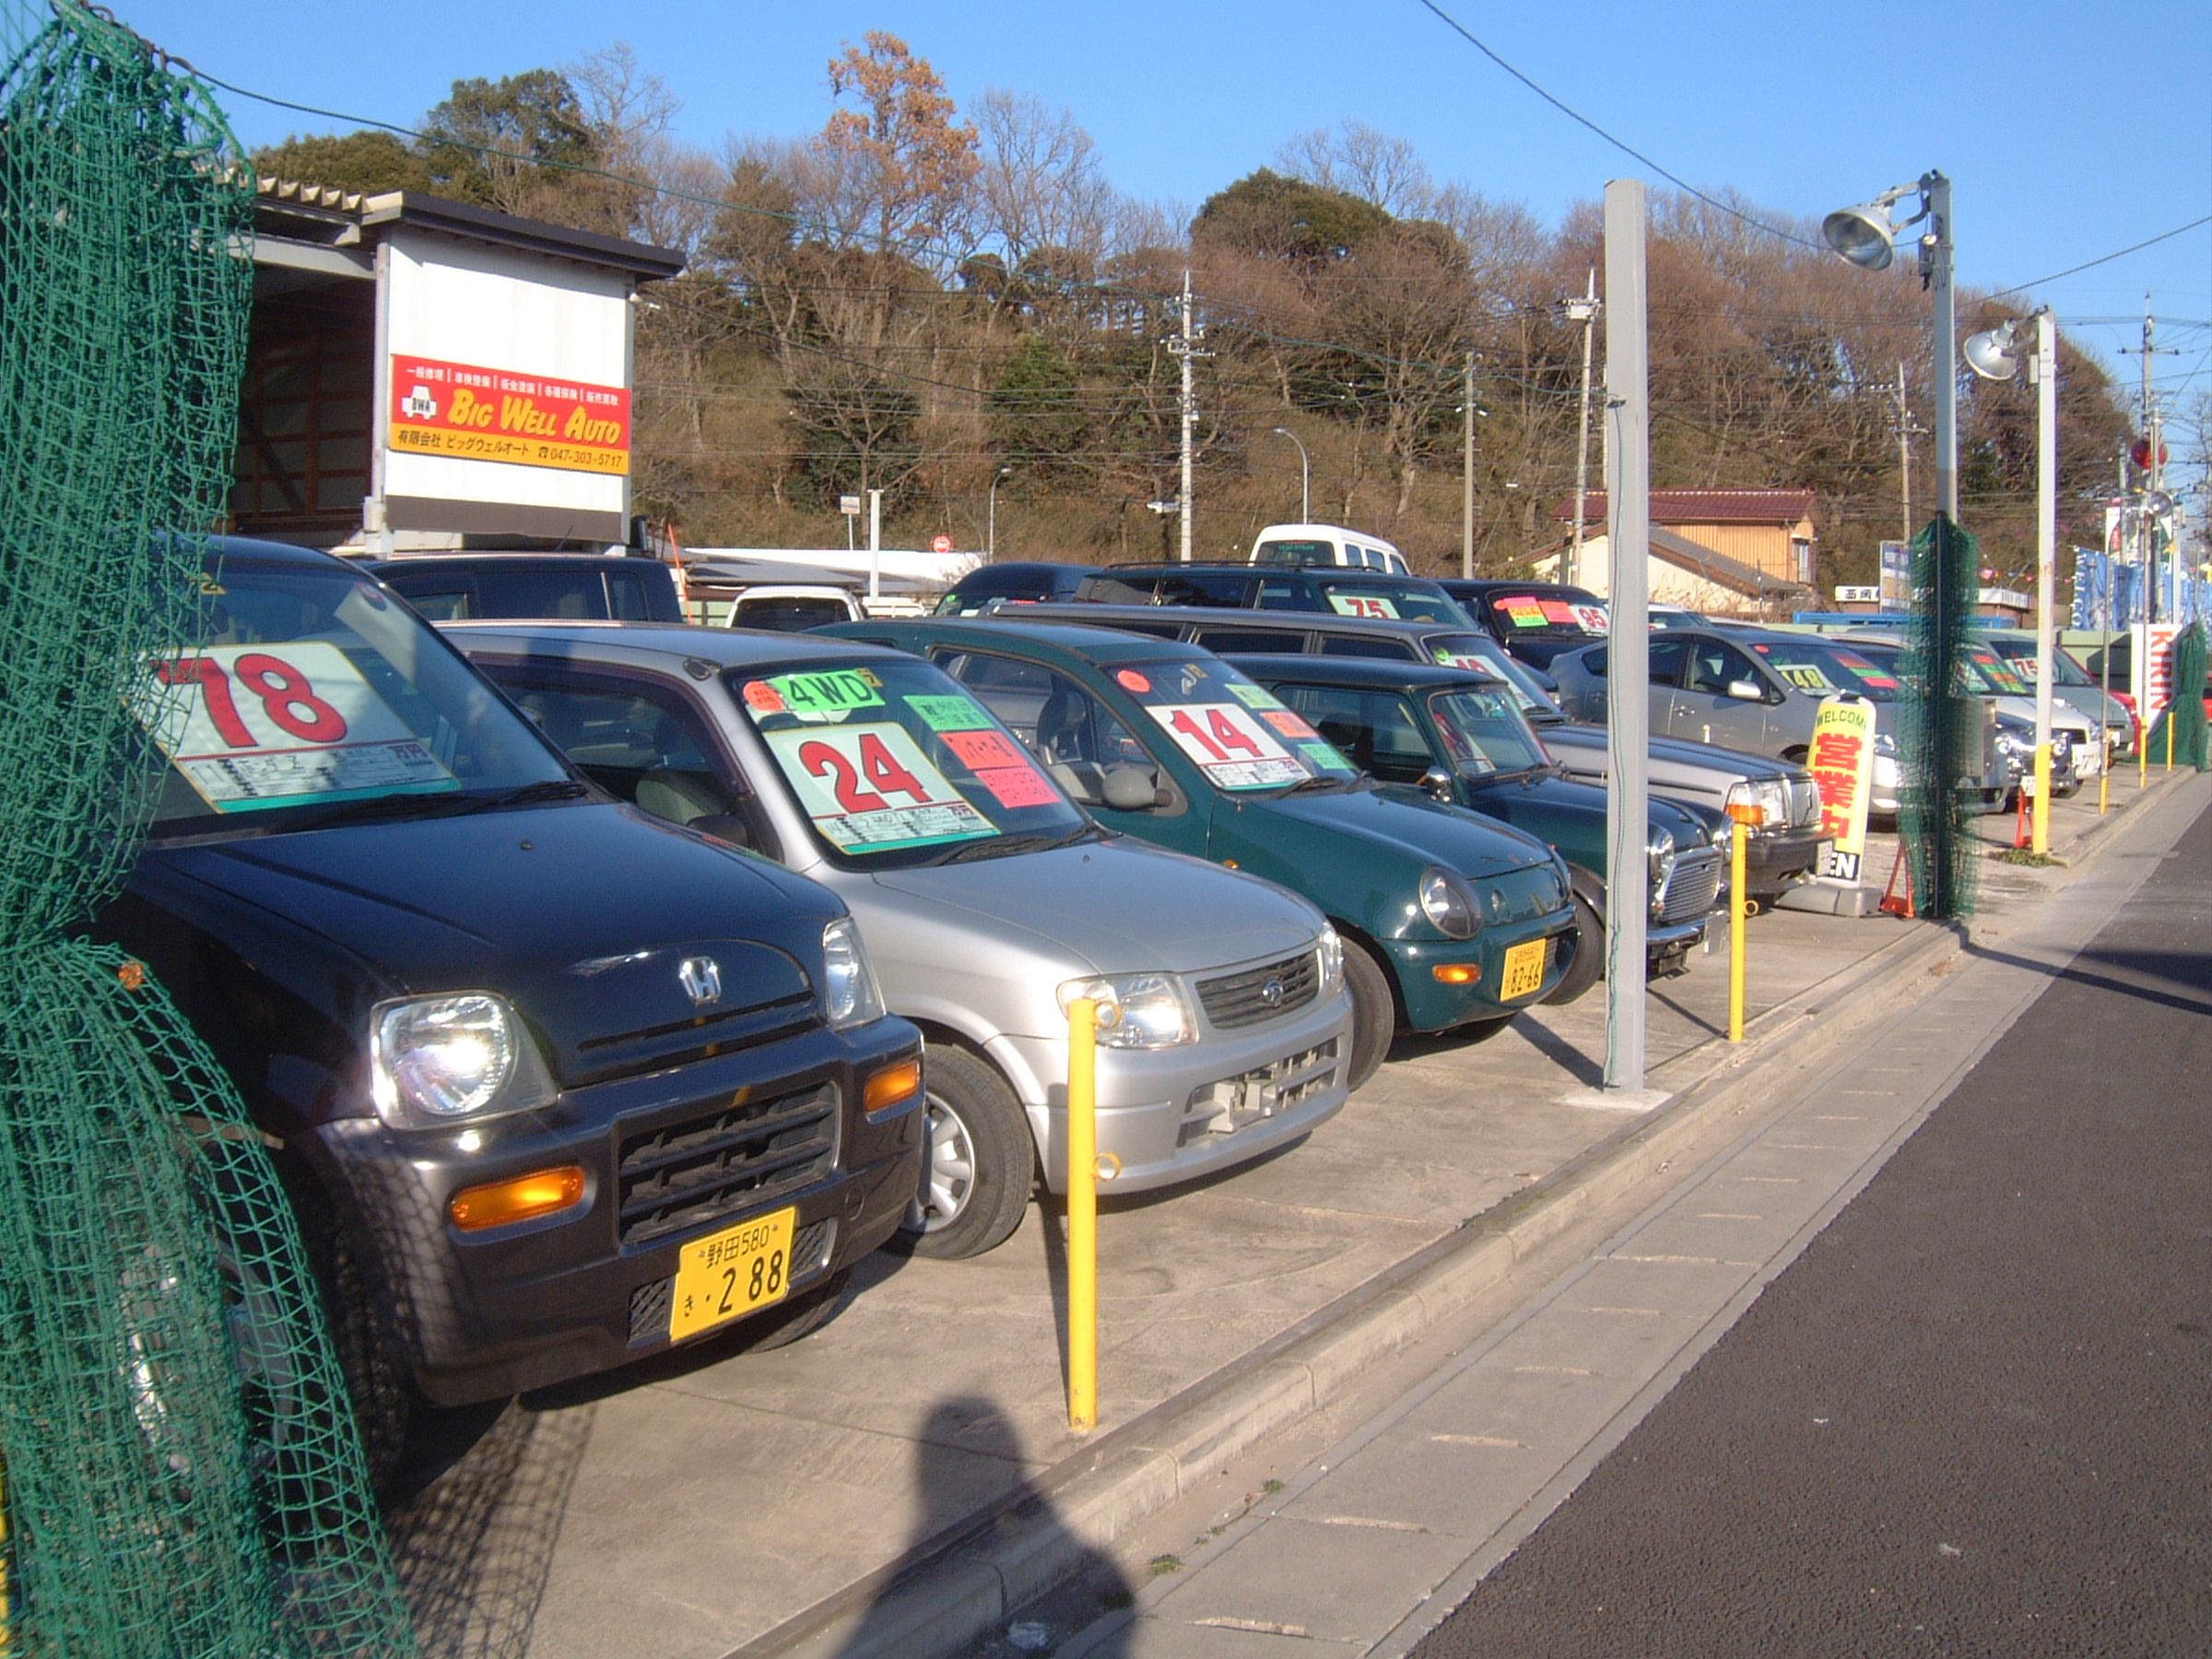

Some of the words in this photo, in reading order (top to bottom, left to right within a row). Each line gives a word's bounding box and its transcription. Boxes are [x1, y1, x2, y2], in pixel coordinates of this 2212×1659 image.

[447, 388, 493, 428] BIG
[500, 395, 557, 436] WELL
[564, 406, 621, 445] AUTO
[398, 429, 441, 448] 有限会社
[447, 434, 529, 456] ビッグウェルオート
[550, 448, 622, 467] 047-303-5717
[1345, 598, 1390, 619] 75
[1579, 607, 1608, 629] 95
[788, 674, 873, 707] 4WD
[2150, 630, 2173, 710] KIRIN
[147, 653, 348, 749] 78
[1817, 709, 1867, 730] WELCOM
[1169, 708, 1265, 761] 14
[798, 733, 933, 815] 24
